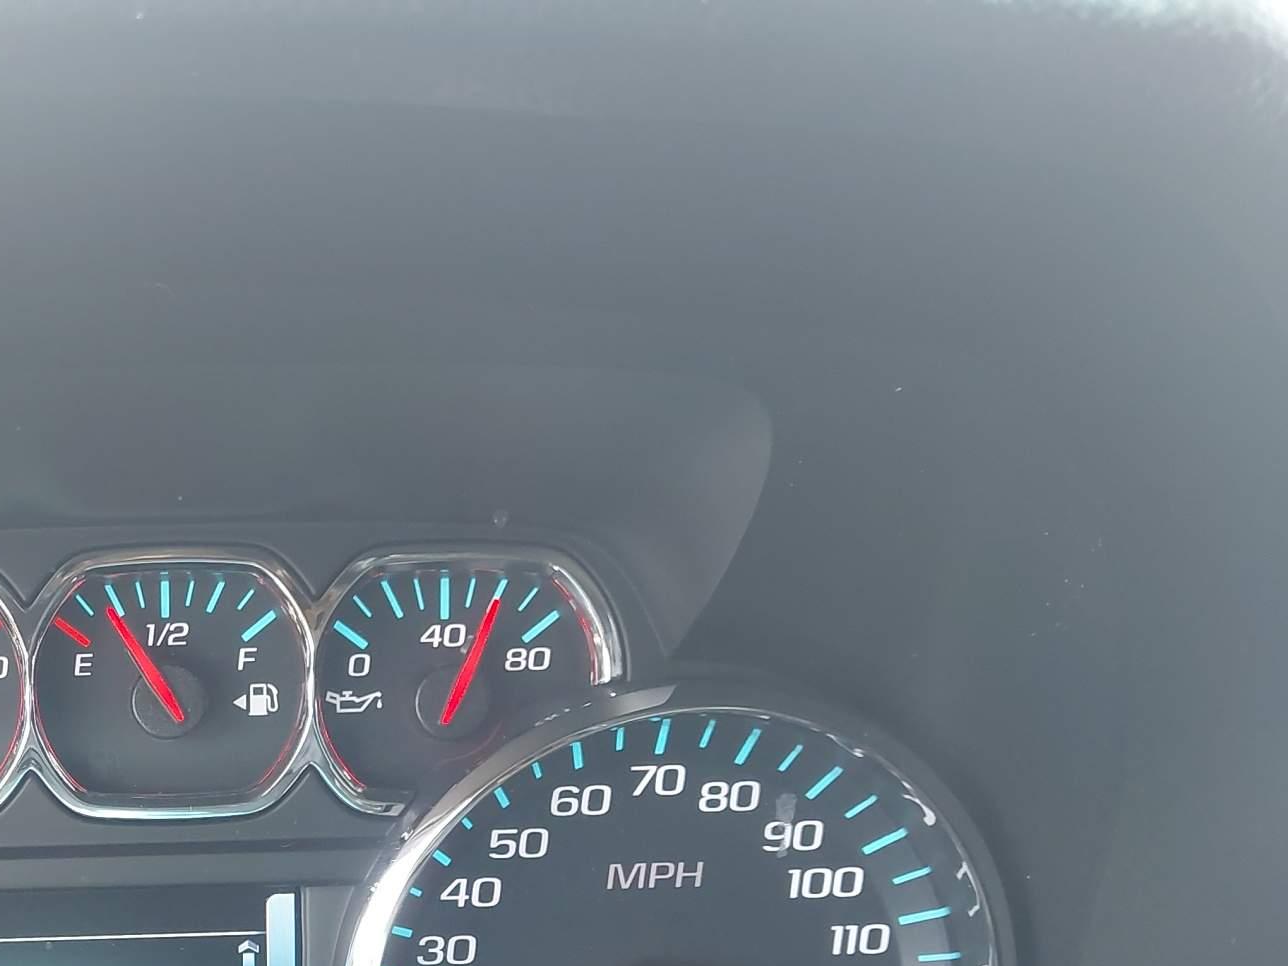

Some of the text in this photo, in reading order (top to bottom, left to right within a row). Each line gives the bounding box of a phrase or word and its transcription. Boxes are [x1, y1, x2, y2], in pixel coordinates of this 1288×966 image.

[146, 622, 189, 647] 1/2
[420, 623, 467, 648] 40
[74, 653, 94, 676] E
[237, 647, 258, 671] F
[348, 653, 371, 677] 0
[504, 647, 551, 671] 80
[630, 764, 686, 796] 70
[550, 784, 612, 817] 60
[698, 780, 761, 812] 80
[488, 828, 549, 859] 50
[762, 820, 824, 852] 90
[606, 861, 704, 890] MPH
[788, 866, 864, 899] 100
[440, 877, 502, 908] 40
[416, 935, 477, 965] 30
[830, 923, 890, 955] 110
